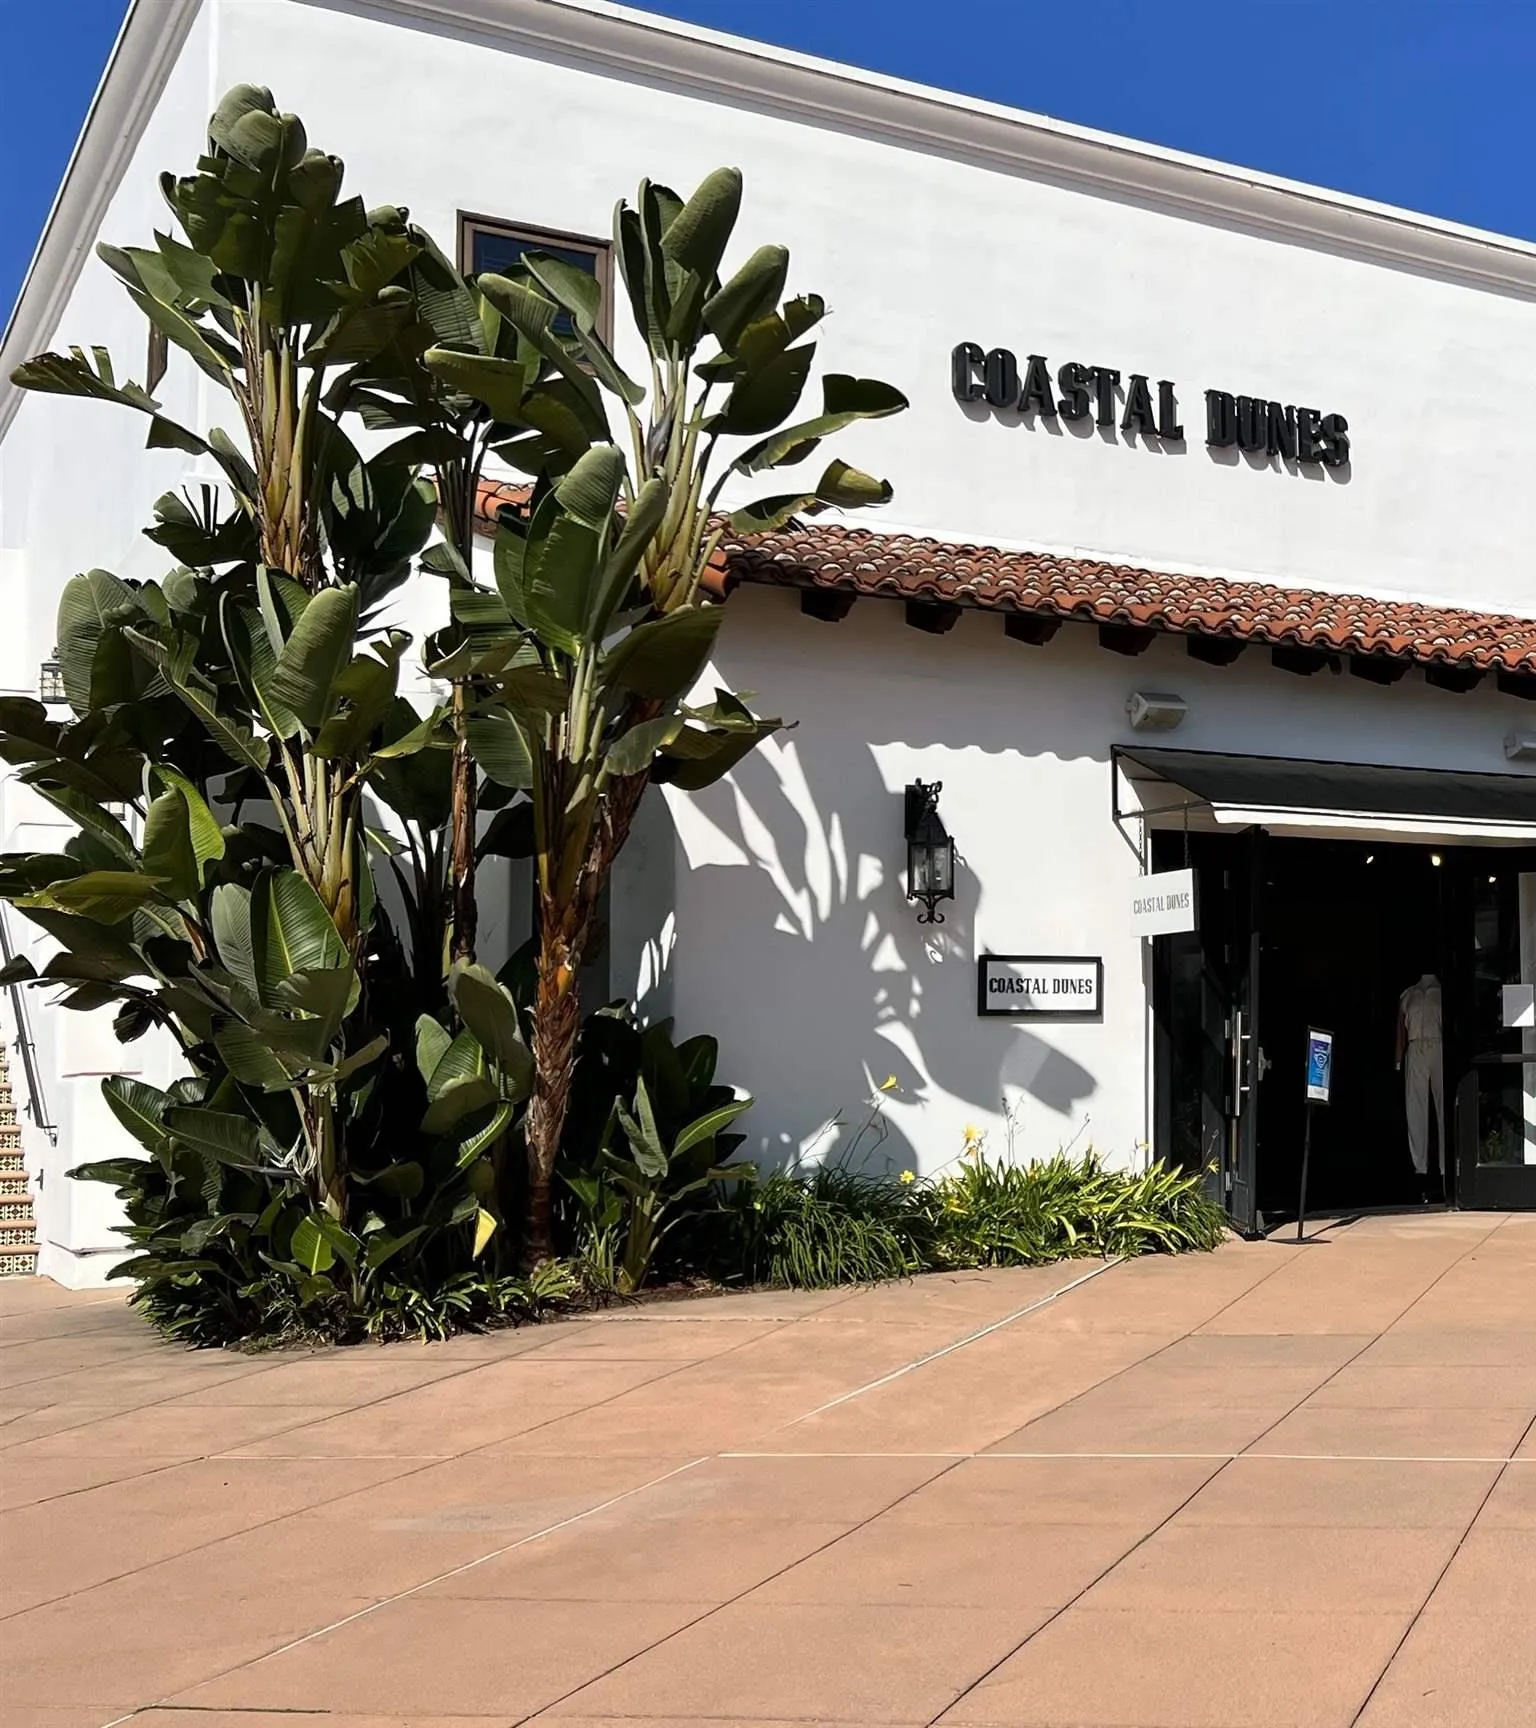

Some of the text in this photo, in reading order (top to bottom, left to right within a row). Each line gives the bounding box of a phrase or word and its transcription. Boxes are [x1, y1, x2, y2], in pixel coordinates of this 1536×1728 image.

[952, 341, 1349, 467] COASTAL DUNES
[1133, 892, 1190, 914] COASTAL DUNES
[988, 977, 1093, 995] COASTAL DUNES
